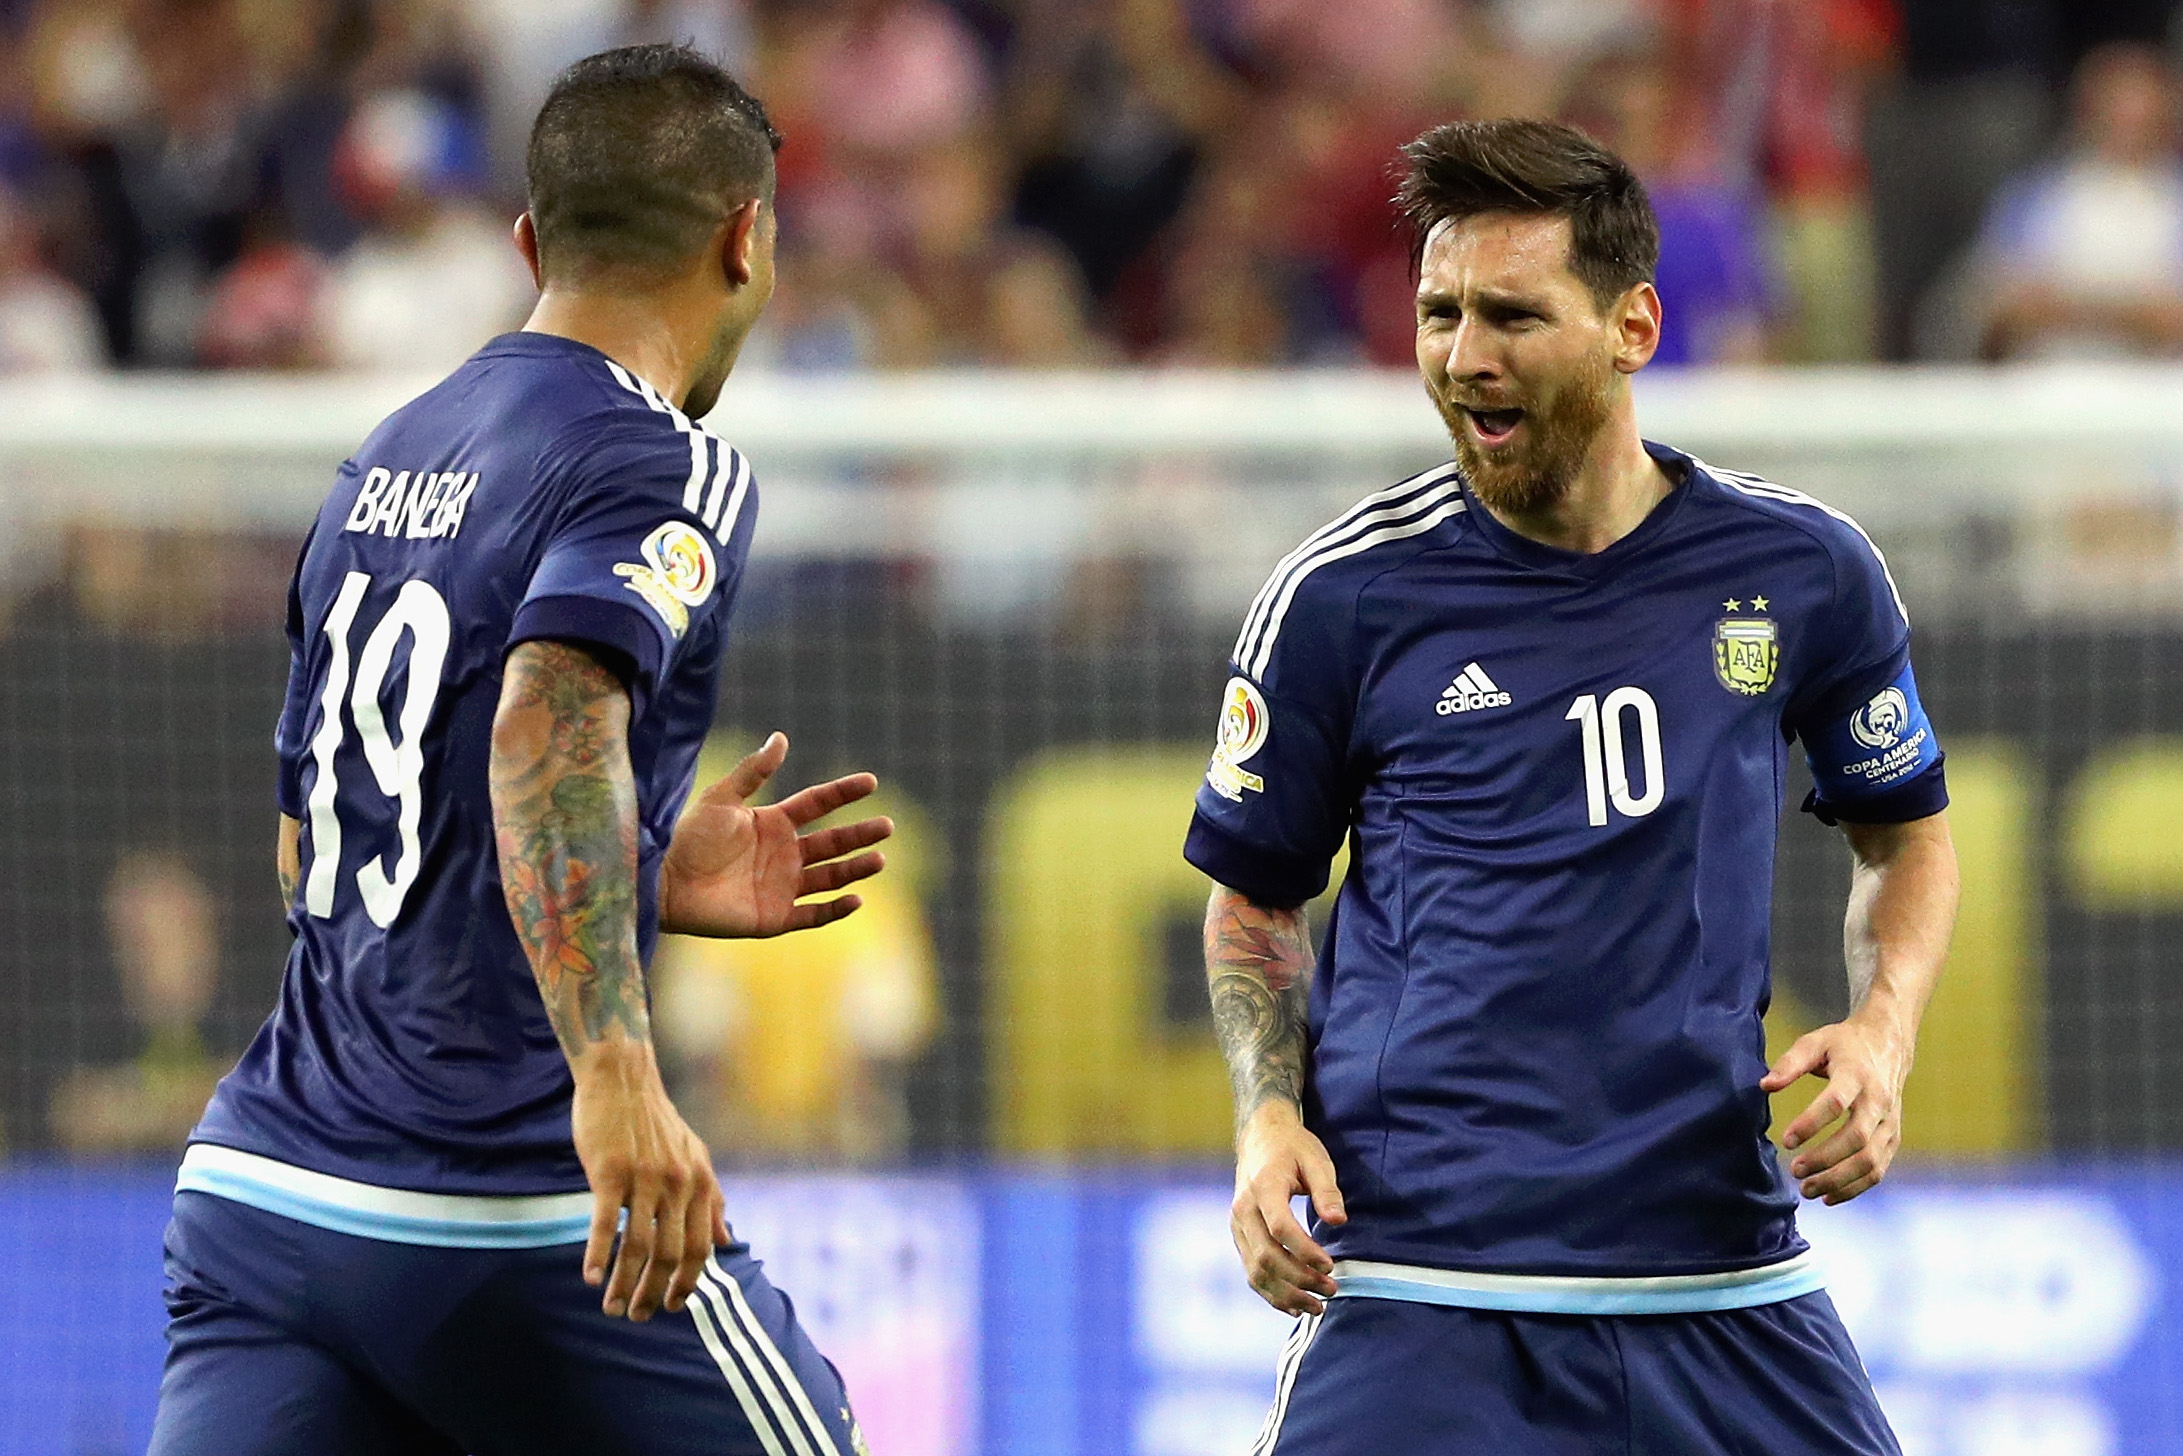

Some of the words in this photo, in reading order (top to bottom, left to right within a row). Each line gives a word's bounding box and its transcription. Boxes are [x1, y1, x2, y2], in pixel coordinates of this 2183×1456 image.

[345, 466, 479, 539] BANEGA
[1732, 640, 1766, 674] AFA
[1435, 691, 1512, 716] adidas
[305, 571, 452, 929] 19
[1564, 686, 1666, 827] 10
[1865, 748, 1919, 779] CENTENARIO
[1843, 758, 1881, 775] COPA
[1881, 773, 1898, 783] USA
